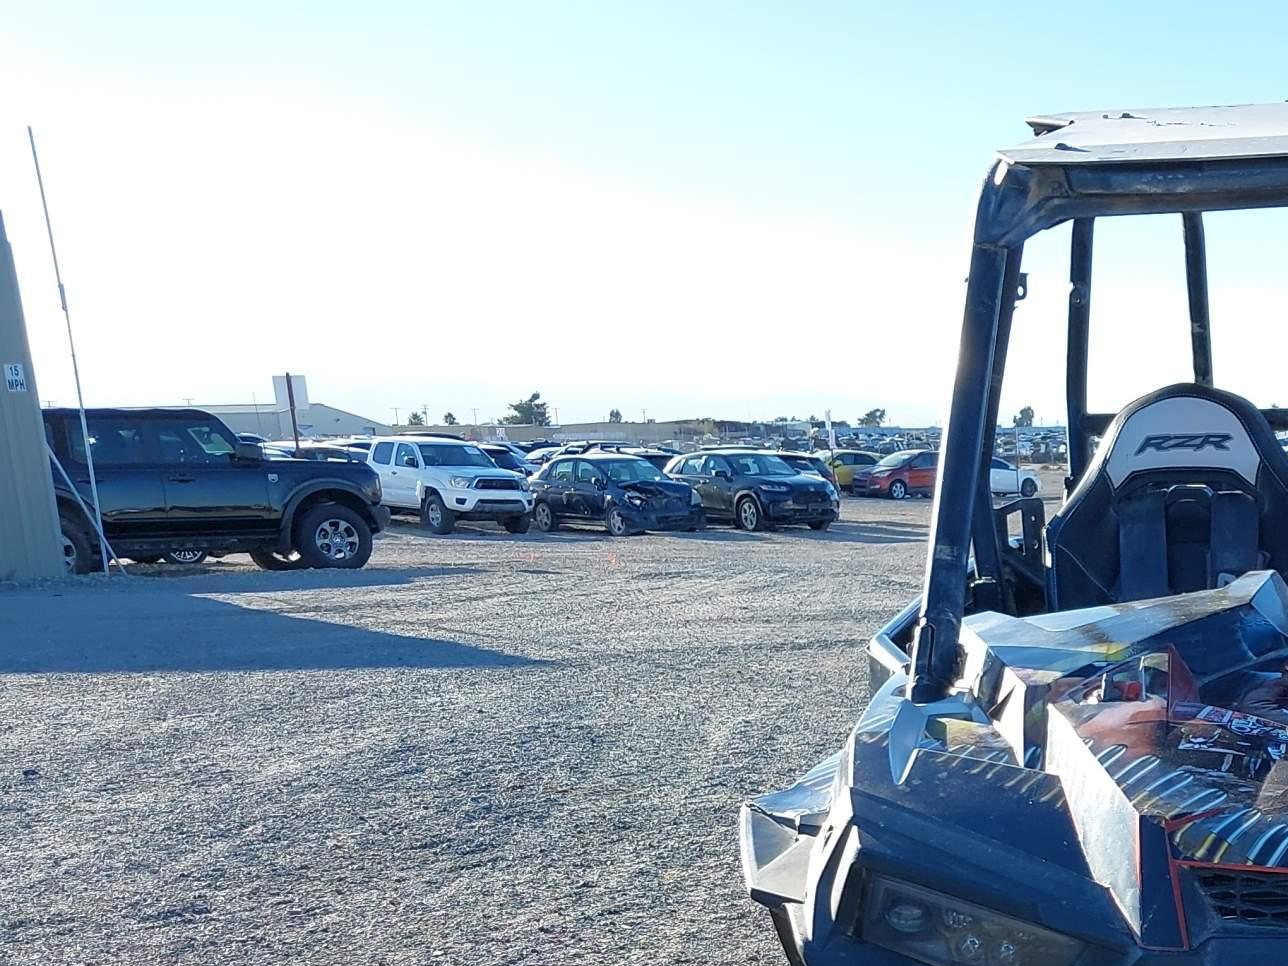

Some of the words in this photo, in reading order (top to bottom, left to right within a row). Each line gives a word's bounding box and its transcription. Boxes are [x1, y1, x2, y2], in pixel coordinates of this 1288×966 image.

[9, 365, 19, 376] 15
[8, 379, 25, 391] MPH
[1134, 432, 1234, 456] RZR
